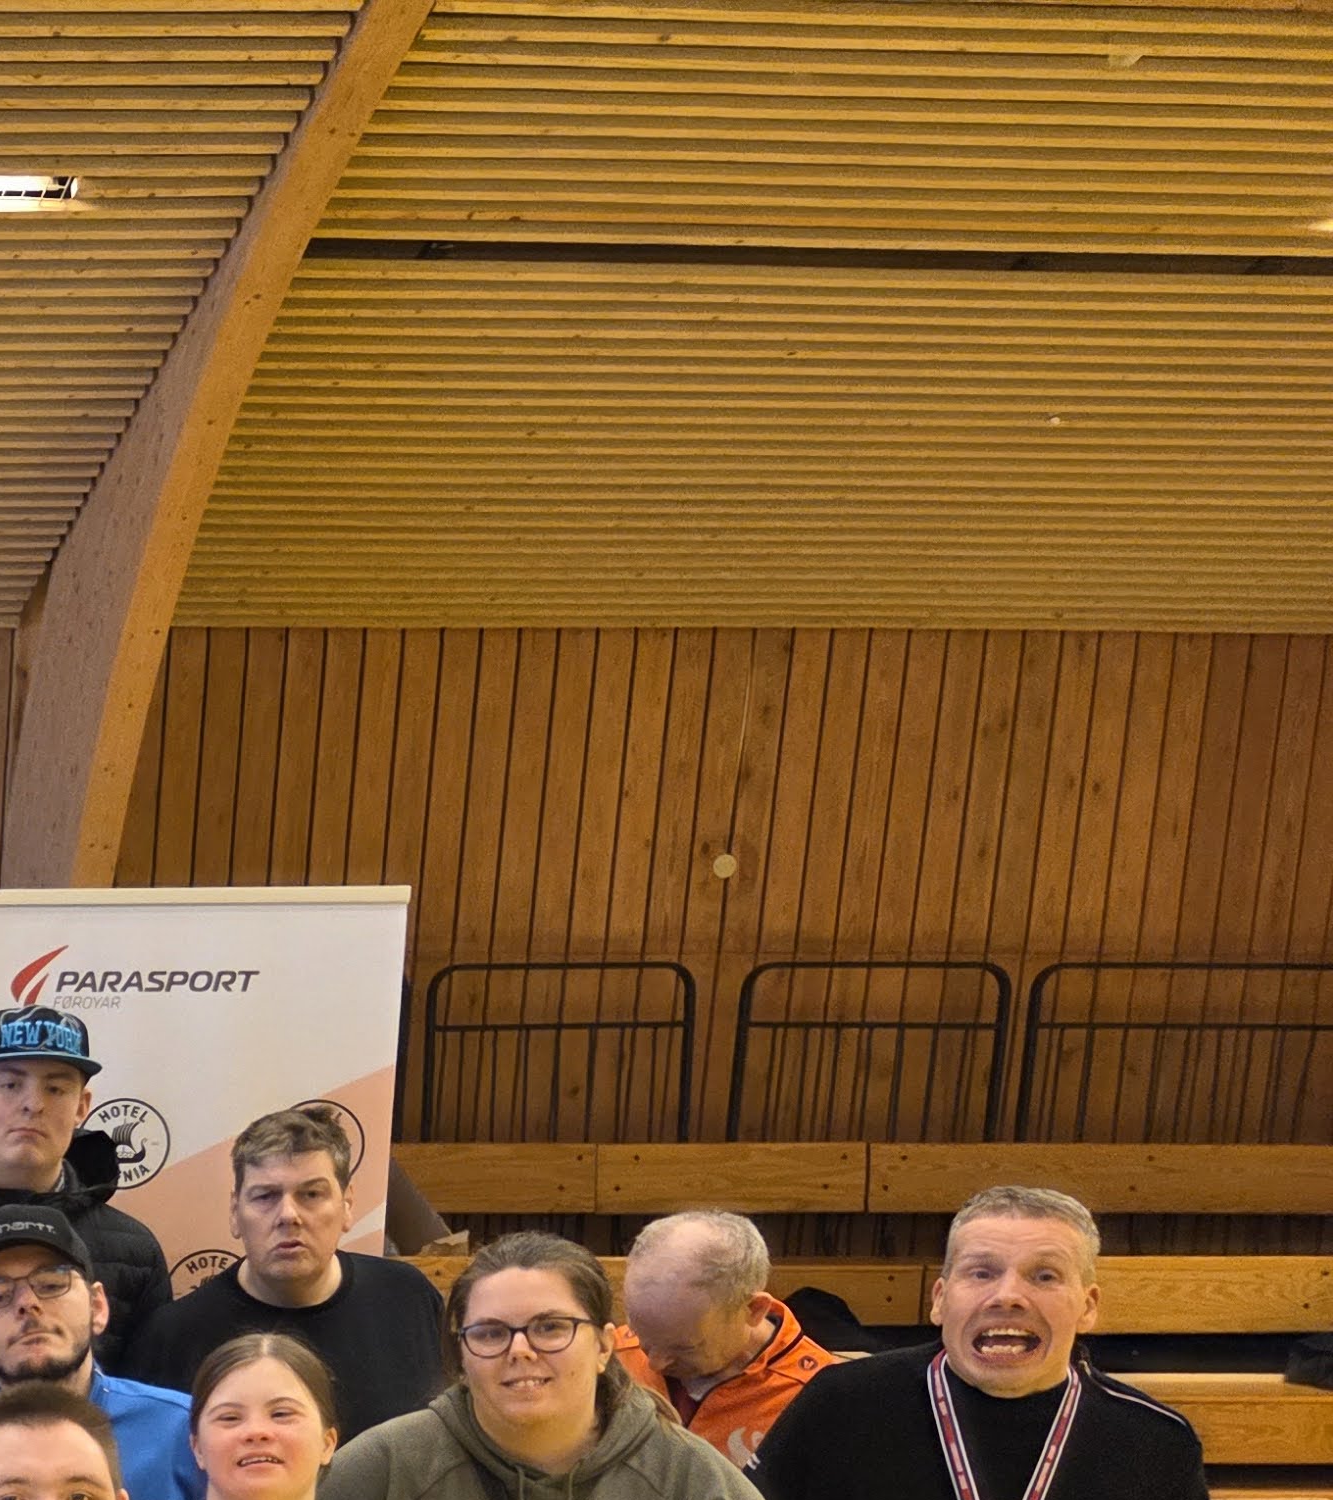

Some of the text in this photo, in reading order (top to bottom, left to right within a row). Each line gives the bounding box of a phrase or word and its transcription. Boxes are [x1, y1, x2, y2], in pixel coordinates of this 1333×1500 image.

[55, 970, 261, 993] PARASPORT
[0, 1021, 83, 1057] NEW YORK
[98, 1104, 148, 1124] HOTEL
[185, 1255, 230, 1275] HOTE
